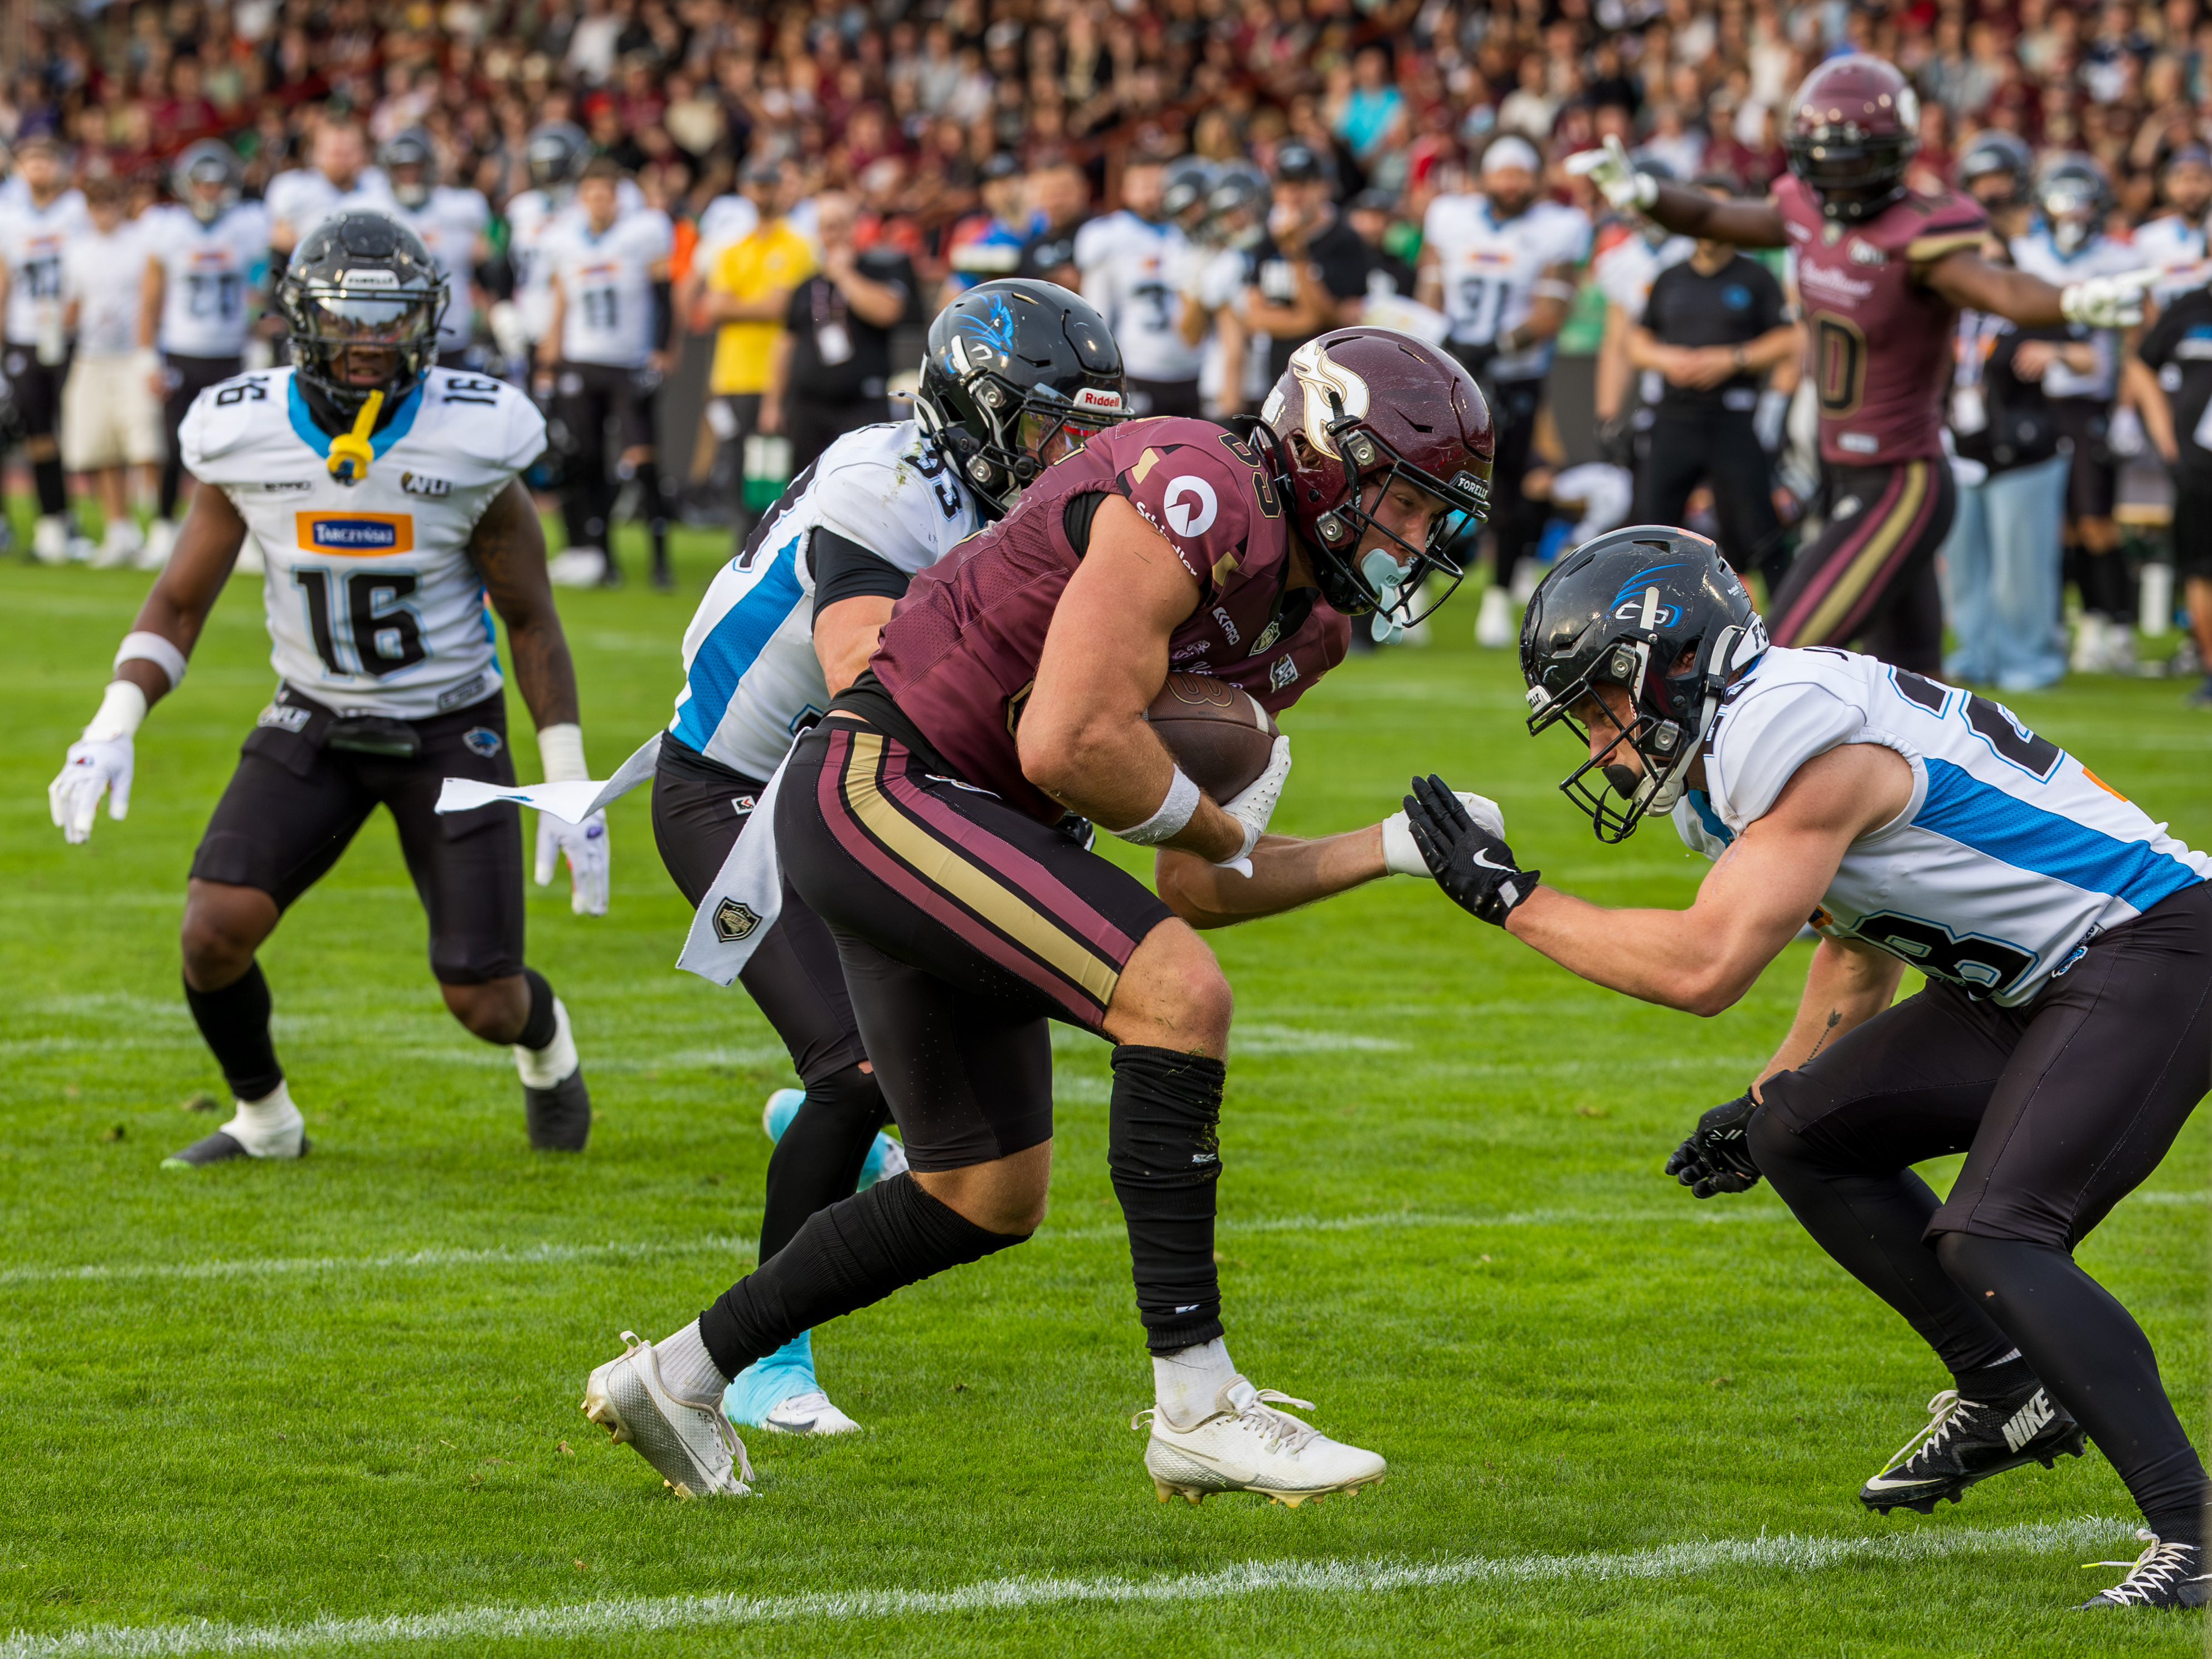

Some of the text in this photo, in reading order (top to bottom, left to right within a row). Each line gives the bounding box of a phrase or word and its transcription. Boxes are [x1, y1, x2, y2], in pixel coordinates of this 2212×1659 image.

[1085, 392, 1120, 407] Riddell
[293, 566, 432, 681] 16
[2001, 1387, 2055, 1454] NIKE
